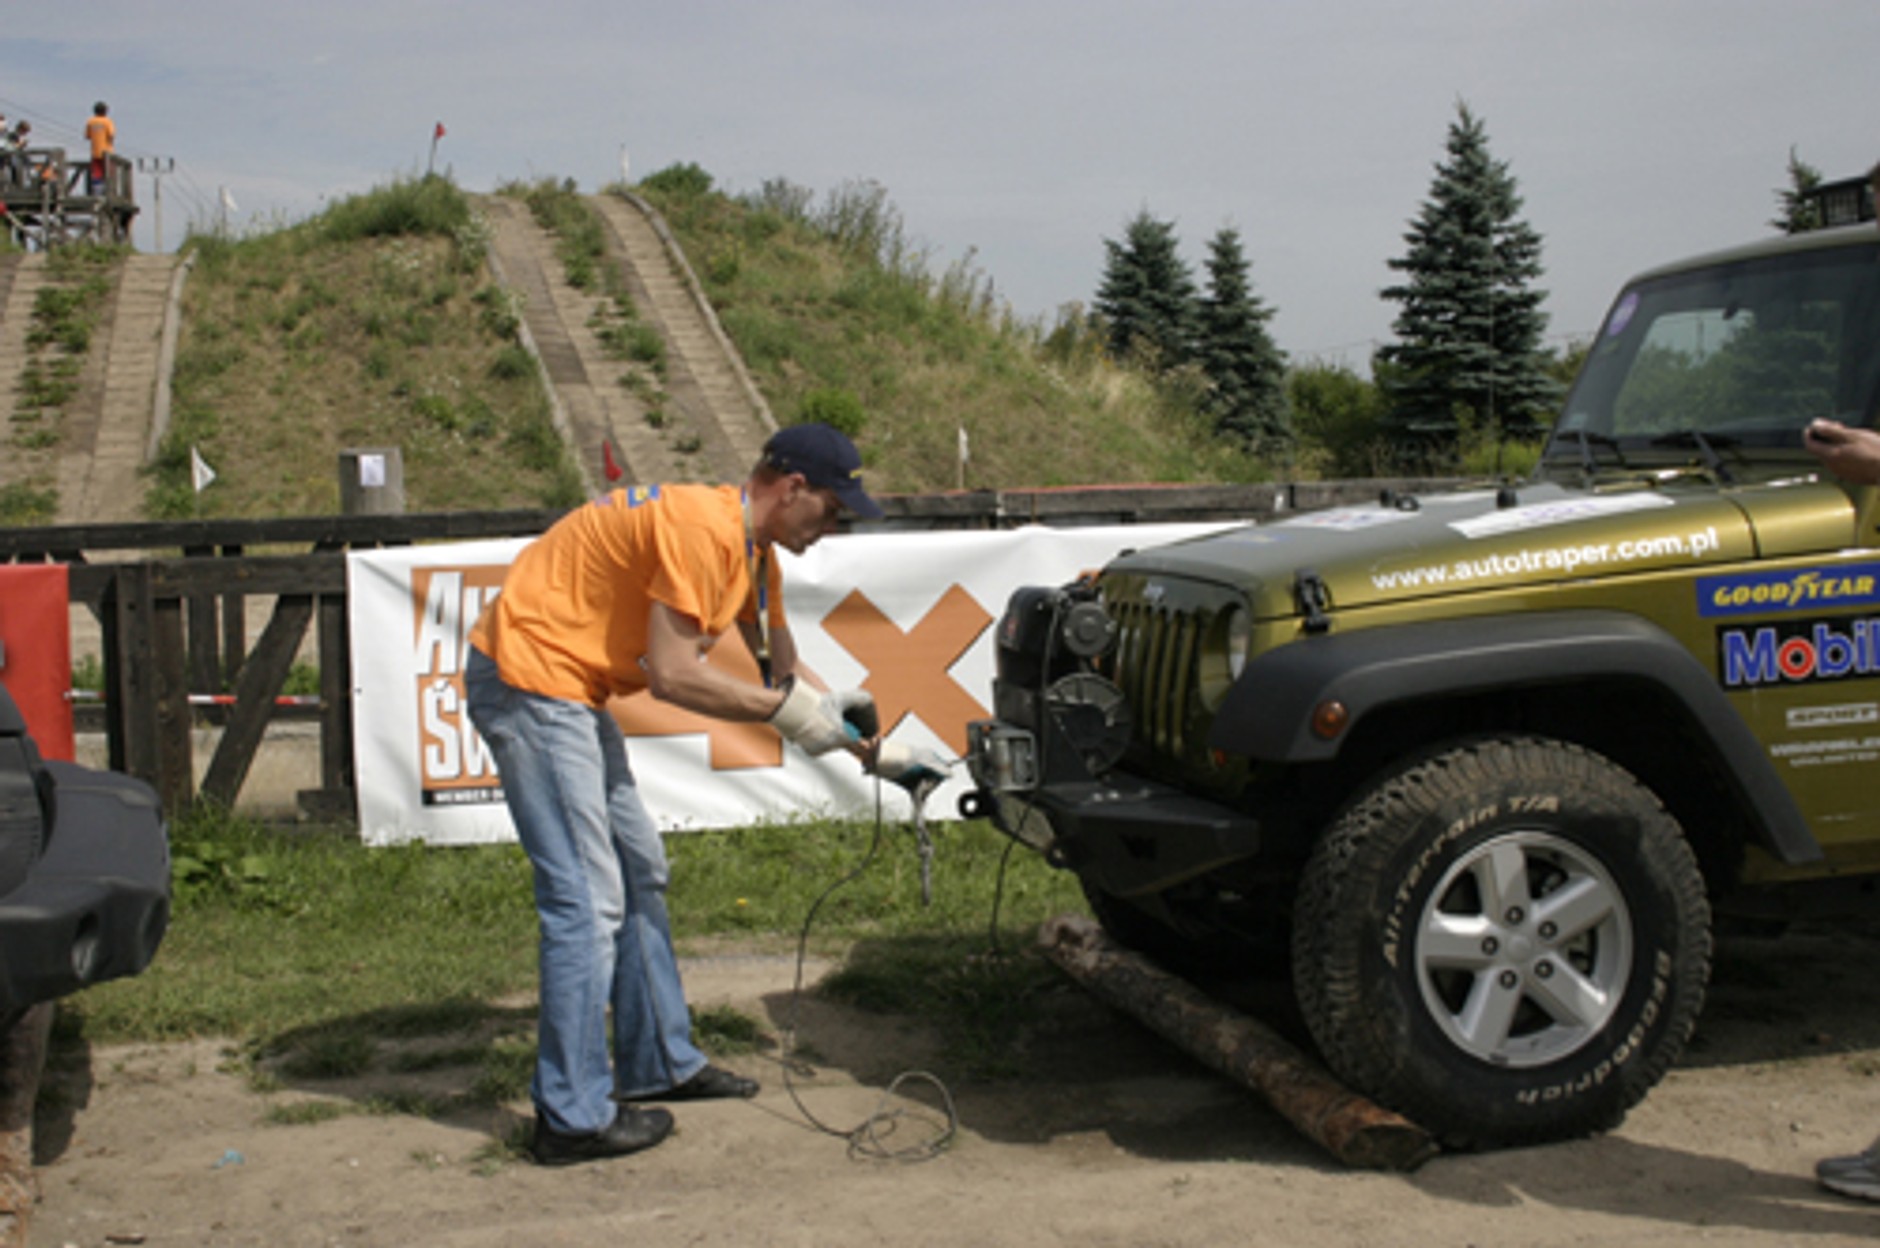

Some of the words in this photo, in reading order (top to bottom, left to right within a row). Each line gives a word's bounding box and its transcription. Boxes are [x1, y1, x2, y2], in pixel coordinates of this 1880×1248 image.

[1371, 526, 1720, 590] www.autotraper.com.pl
[1713, 571, 1875, 606] GOODYEAR
[1723, 617, 1880, 685] Mobil
[1508, 796, 1561, 813] T/A
